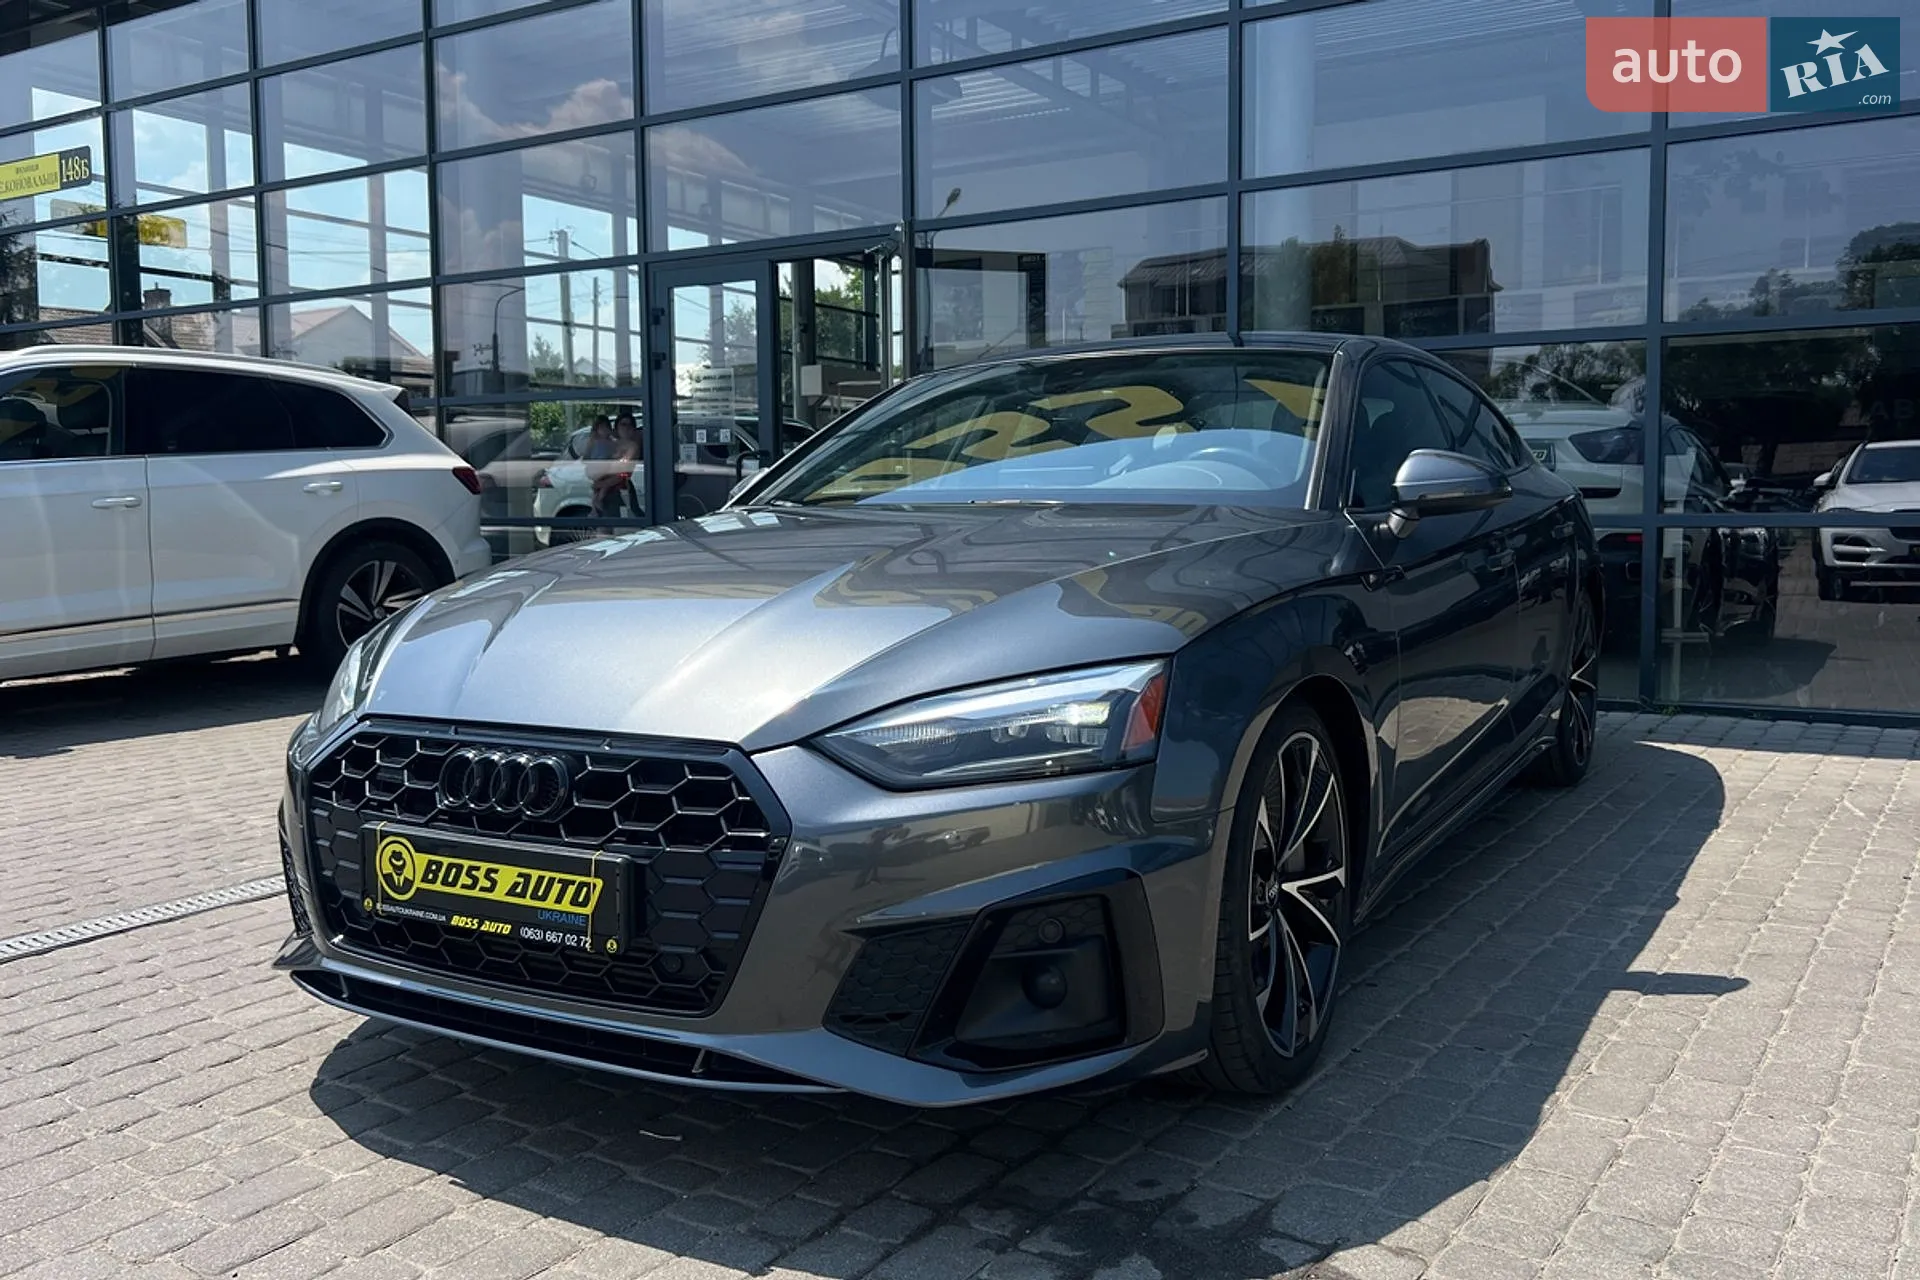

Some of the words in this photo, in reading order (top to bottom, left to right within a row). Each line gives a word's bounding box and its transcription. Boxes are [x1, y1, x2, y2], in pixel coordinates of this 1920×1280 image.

[61, 156, 90, 182] 148Б
[421, 859, 500, 894] BOSS
[505, 872, 596, 908] AUTO
[451, 915, 479, 929] BOSS
[480, 920, 512, 935] AUTO
[538, 910, 587, 926] UKRAINE
[520, 926, 544, 941] (063)
[545, 930, 563, 944] 667
[565, 933, 578, 947] 02
